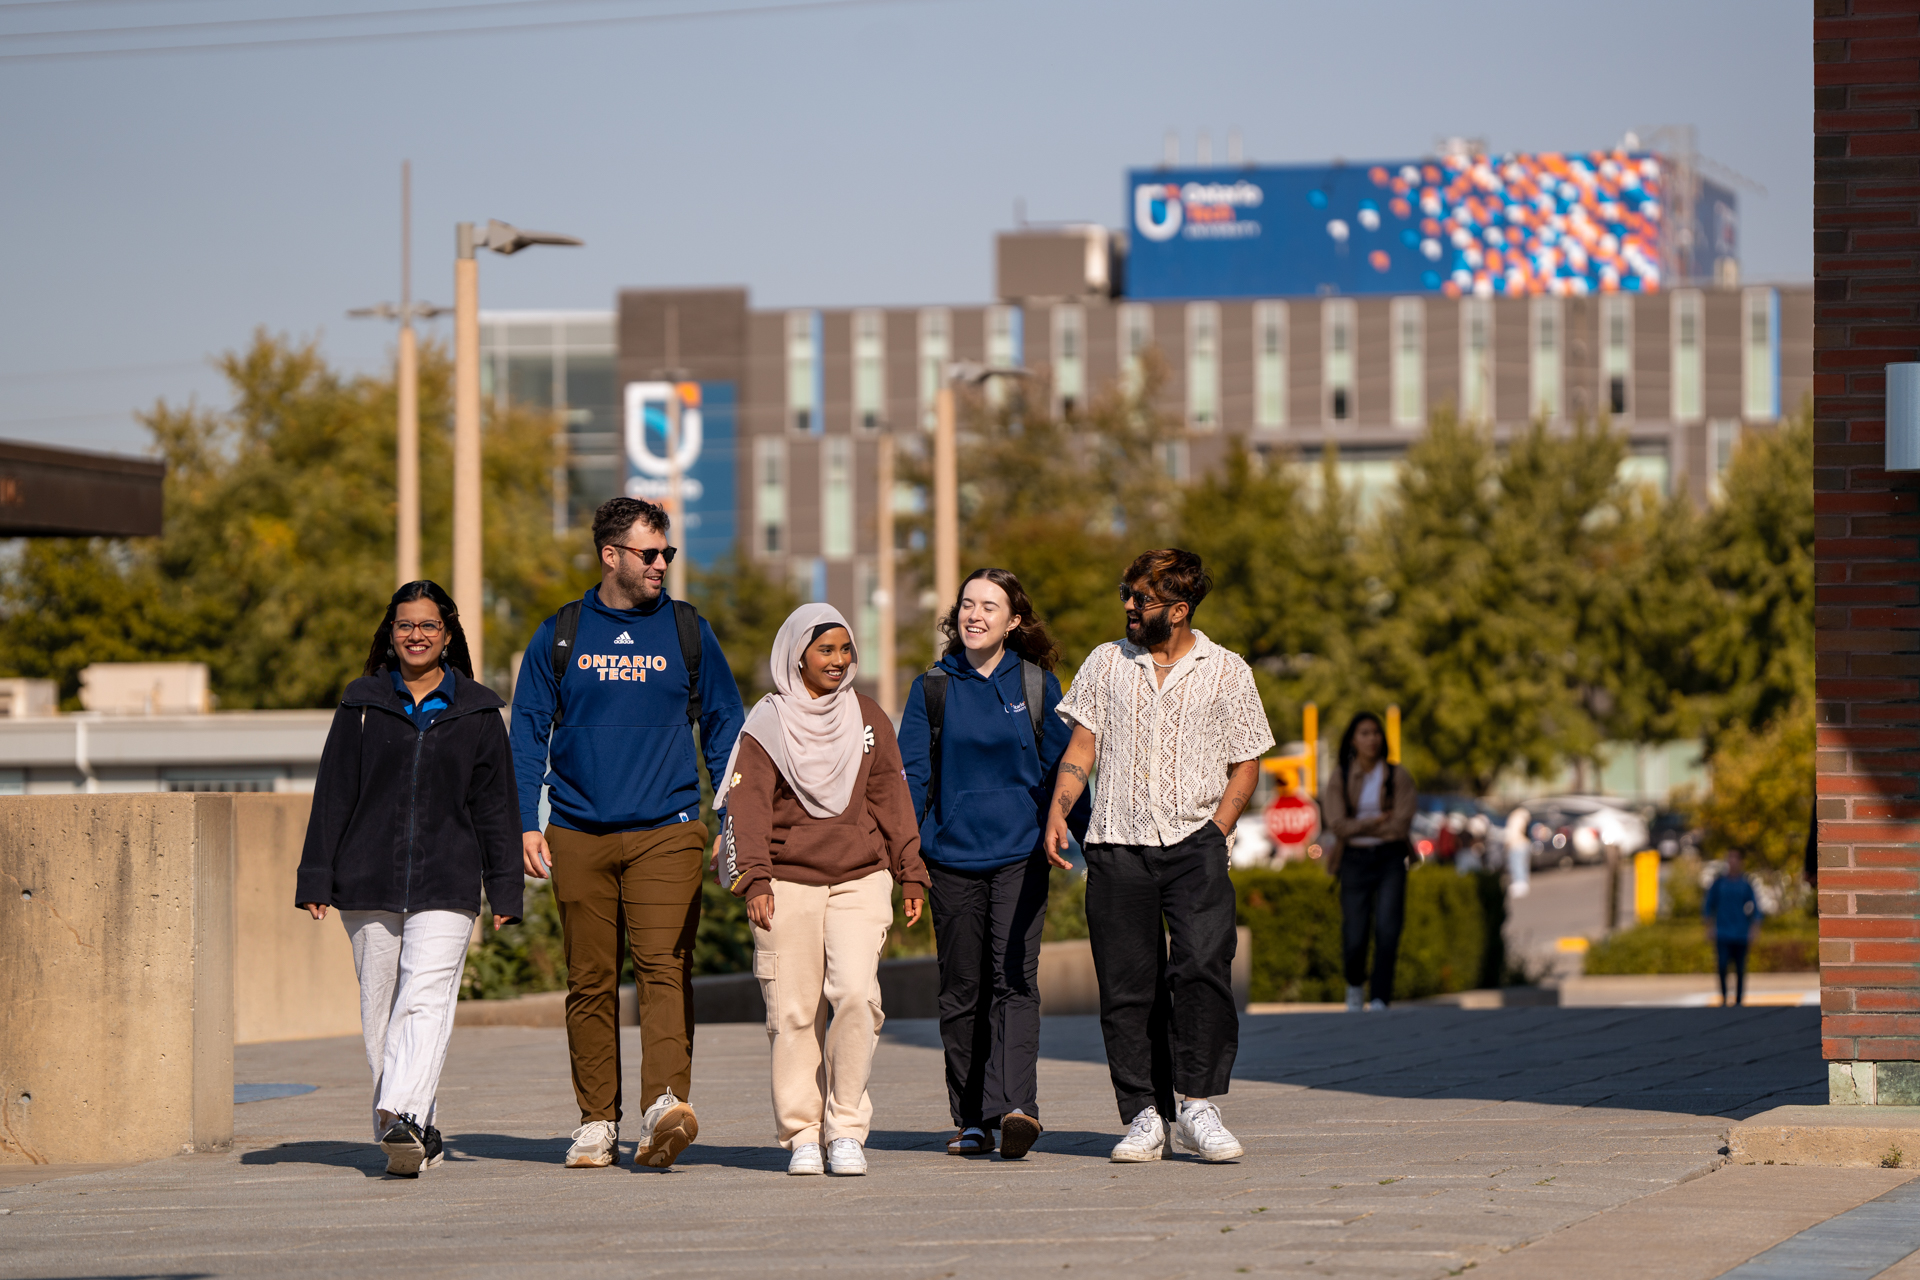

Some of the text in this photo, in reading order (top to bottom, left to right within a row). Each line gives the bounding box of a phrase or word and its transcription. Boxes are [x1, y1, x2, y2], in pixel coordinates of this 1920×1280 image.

[577, 653, 667, 672] ONTARIO
[597, 667, 646, 683] TECH
[1266, 805, 1316, 834] STOP
